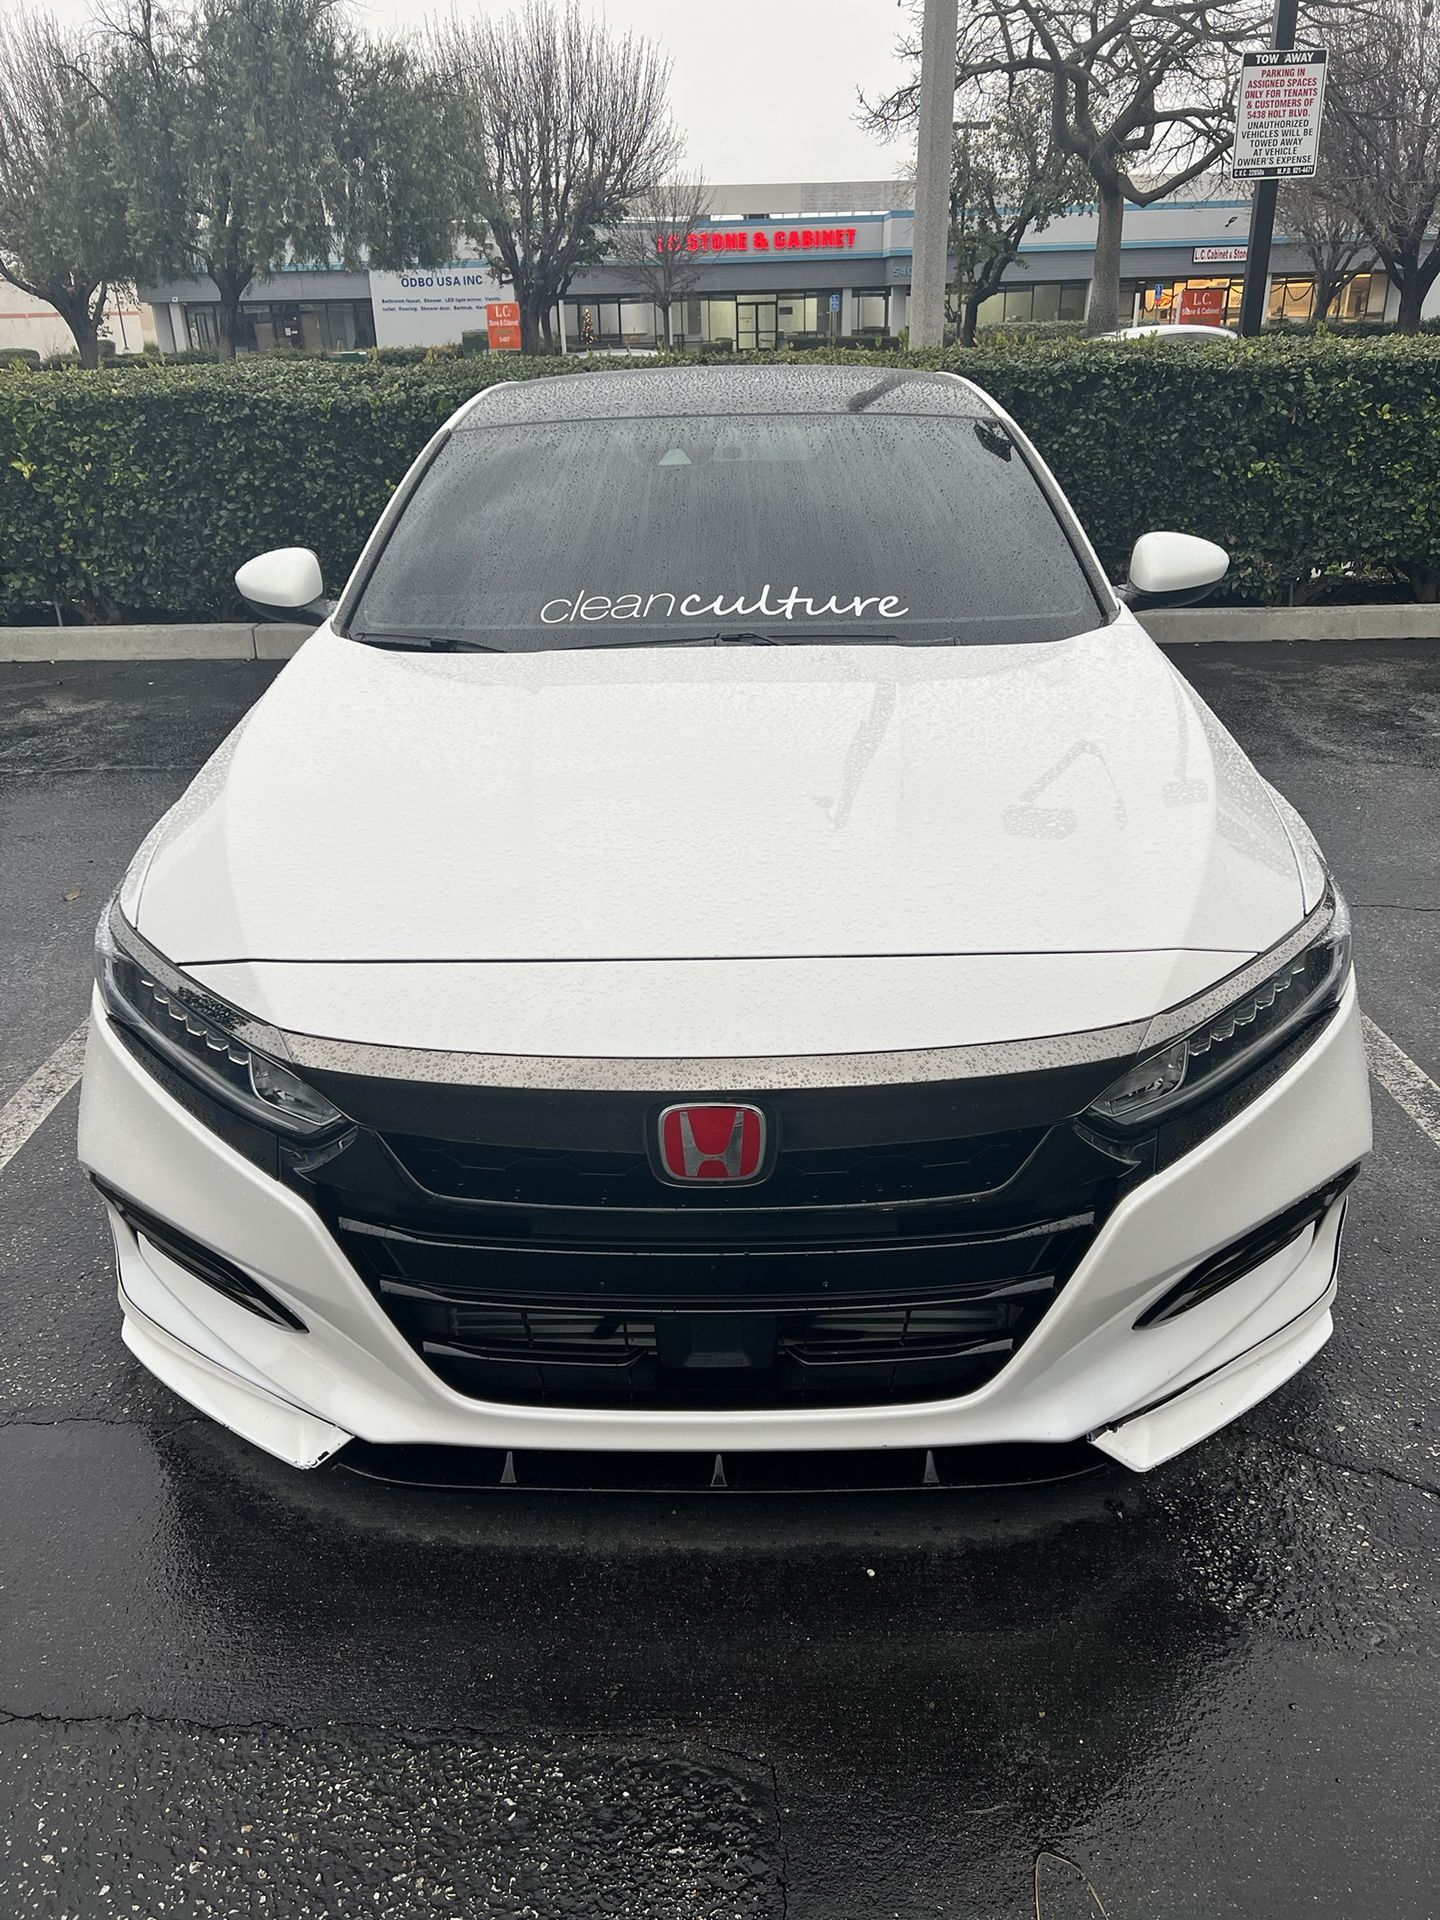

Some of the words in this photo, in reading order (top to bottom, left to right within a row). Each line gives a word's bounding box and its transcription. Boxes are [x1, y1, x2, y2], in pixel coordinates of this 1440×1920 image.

[1255, 53, 1280, 65] TOW
[1284, 52, 1314, 62] AWAY
[1261, 69, 1295, 78] PARKING
[1297, 68, 1306, 77] IN
[1247, 79, 1285, 89] ASSIGNED
[1287, 78, 1318, 87] SPACES
[1244, 90, 1263, 99] ONLY
[1265, 89, 1282, 98] FOR
[1283, 88, 1318, 97] TENANTS
[1246, 101, 1252, 109] &
[1254, 98, 1302, 109] CUSTOMERS
[1303, 98, 1314, 107] OF
[1247, 110, 1266, 119] 5438
[1268, 109, 1286, 118] HOLT
[1288, 108, 1311, 117] BLVD.
[1247, 119, 1309, 130] UNAUTHORIZED
[1241, 130, 1279, 139] VEHICLES
[1281, 129, 1301, 137] WILL
[1303, 128, 1313, 136] BE
[1250, 139, 1278, 148] TOWED
[1280, 138, 1303, 146] AWAY
[1253, 148, 1263, 157] AT
[1265, 147, 1297, 156] VEHICLE
[1237, 157, 1274, 167] OWNER'S
[1276, 155, 1312, 164] EXPENSE
[687, 231, 748, 252] STONE
[753, 231, 769, 251] &
[774, 228, 857, 249] CABINET
[1207, 249, 1229, 260] Cabinet
[400, 276, 434, 288] ODBO
[436, 275, 462, 287] USA
[463, 274, 483, 286] INC
[1193, 292, 1212, 306] L.C.
